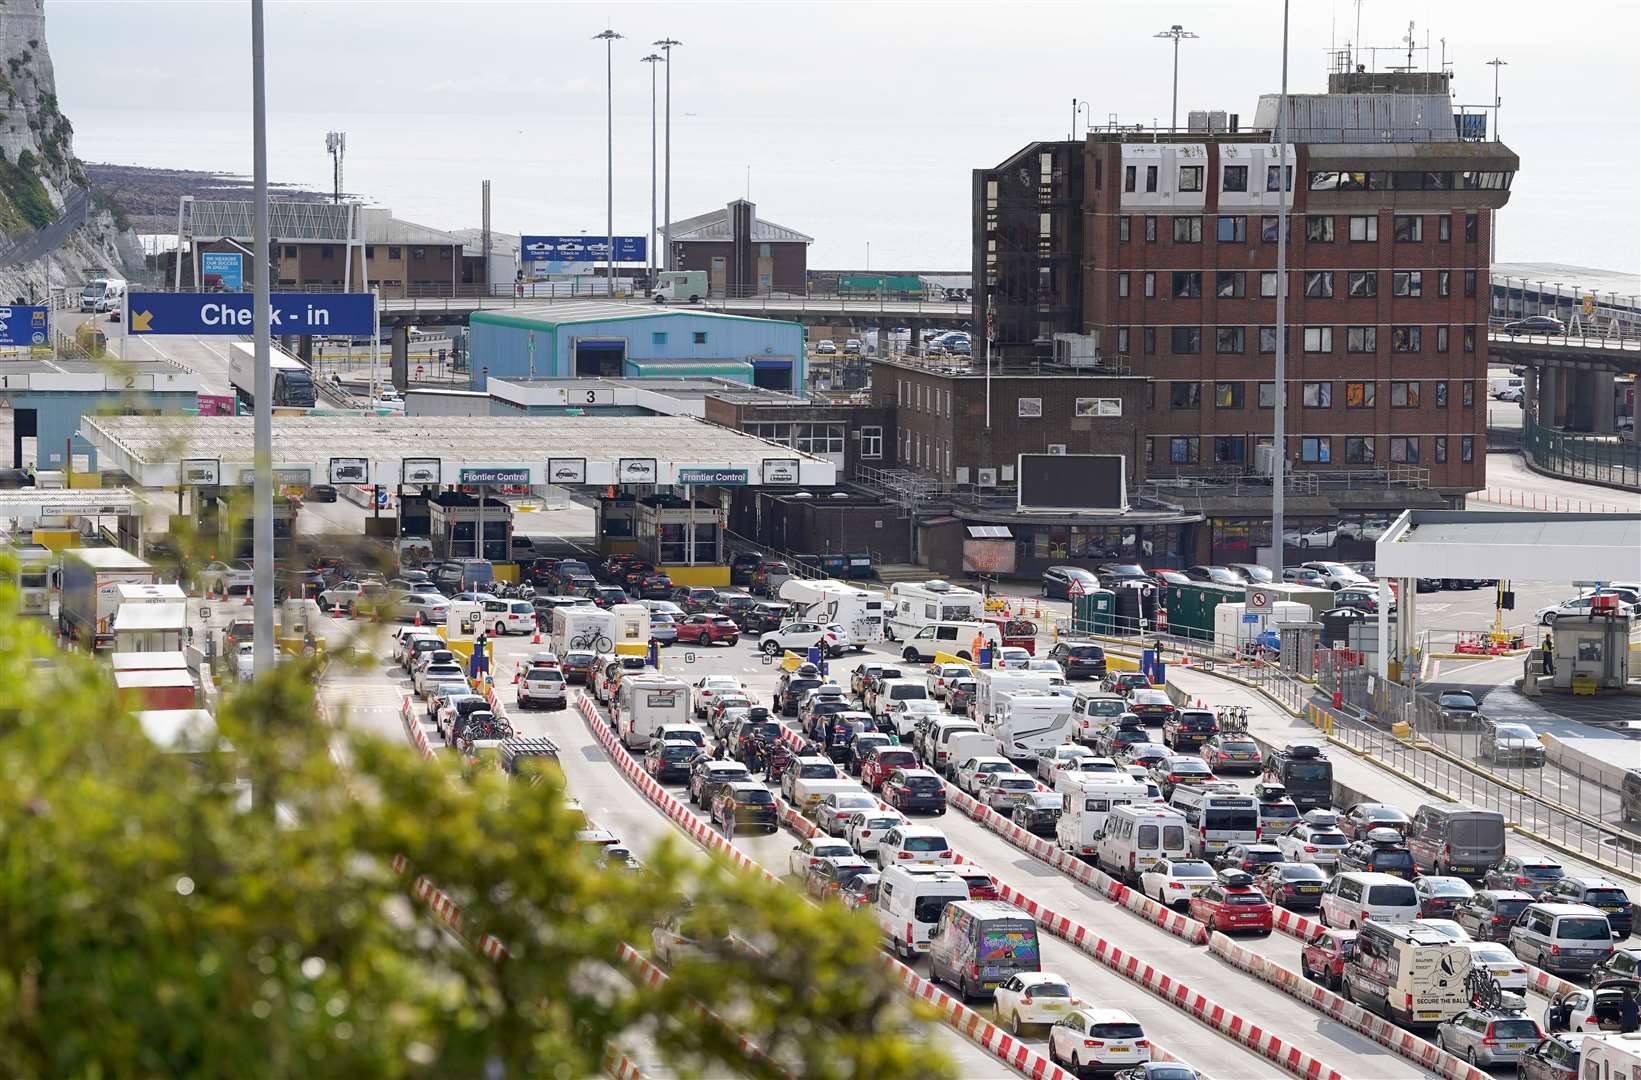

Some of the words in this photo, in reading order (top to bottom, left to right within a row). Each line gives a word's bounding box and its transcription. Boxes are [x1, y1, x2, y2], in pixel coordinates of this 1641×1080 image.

[201, 304, 282, 325] Chek
[307, 304, 329, 325] in
[1, 375, 8, 388] 1
[125, 376, 135, 389] 2
[586, 390, 596, 403] 3
[278, 472, 309, 481] Control
[463, 473, 496, 481] Frontier
[497, 473, 528, 481] Control
[682, 473, 714, 481] Frontier
[715, 473, 746, 481] Control
